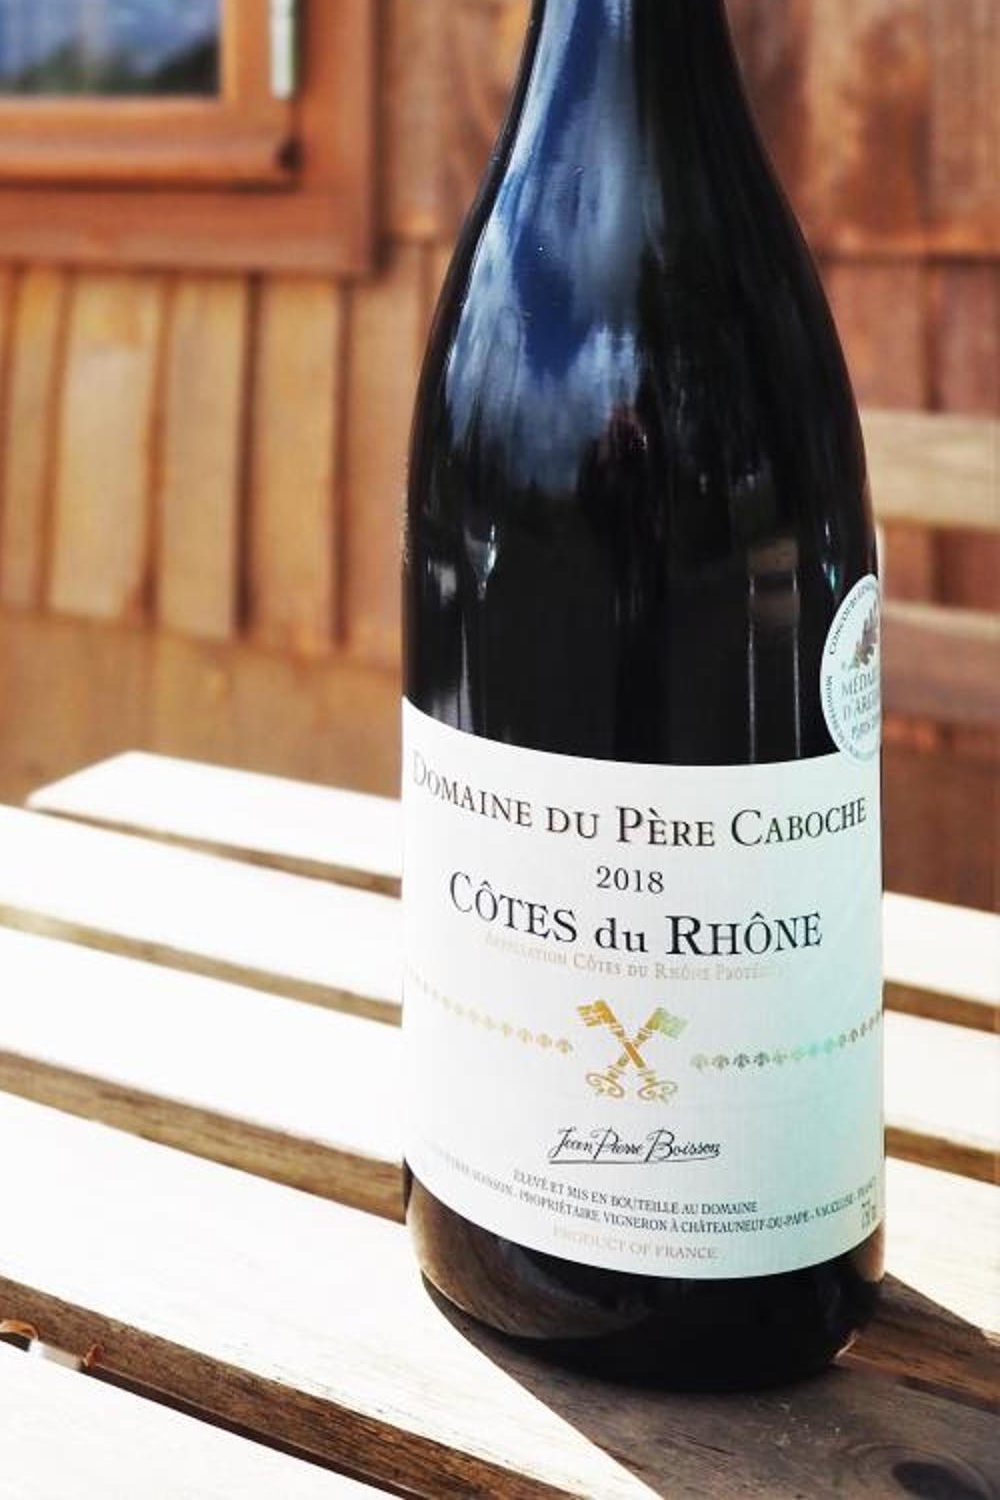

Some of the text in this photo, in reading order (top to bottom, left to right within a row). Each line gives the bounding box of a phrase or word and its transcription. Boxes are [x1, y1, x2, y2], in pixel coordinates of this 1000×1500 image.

[412, 750, 867, 847] DOMAINE DU PÈRE CABOCHE
[596, 865, 664, 894] 2018
[450, 871, 823, 957] CÔTES du RHÔNE
[567, 1185, 589, 1201] MIS
[591, 1190, 607, 1204] EN
[610, 1194, 679, 1215] BOUTEILLE
[682, 1202, 699, 1215] AU
[701, 1201, 758, 1216] DOMAINE
[603, 1210, 668, 1232] VIGNERON
